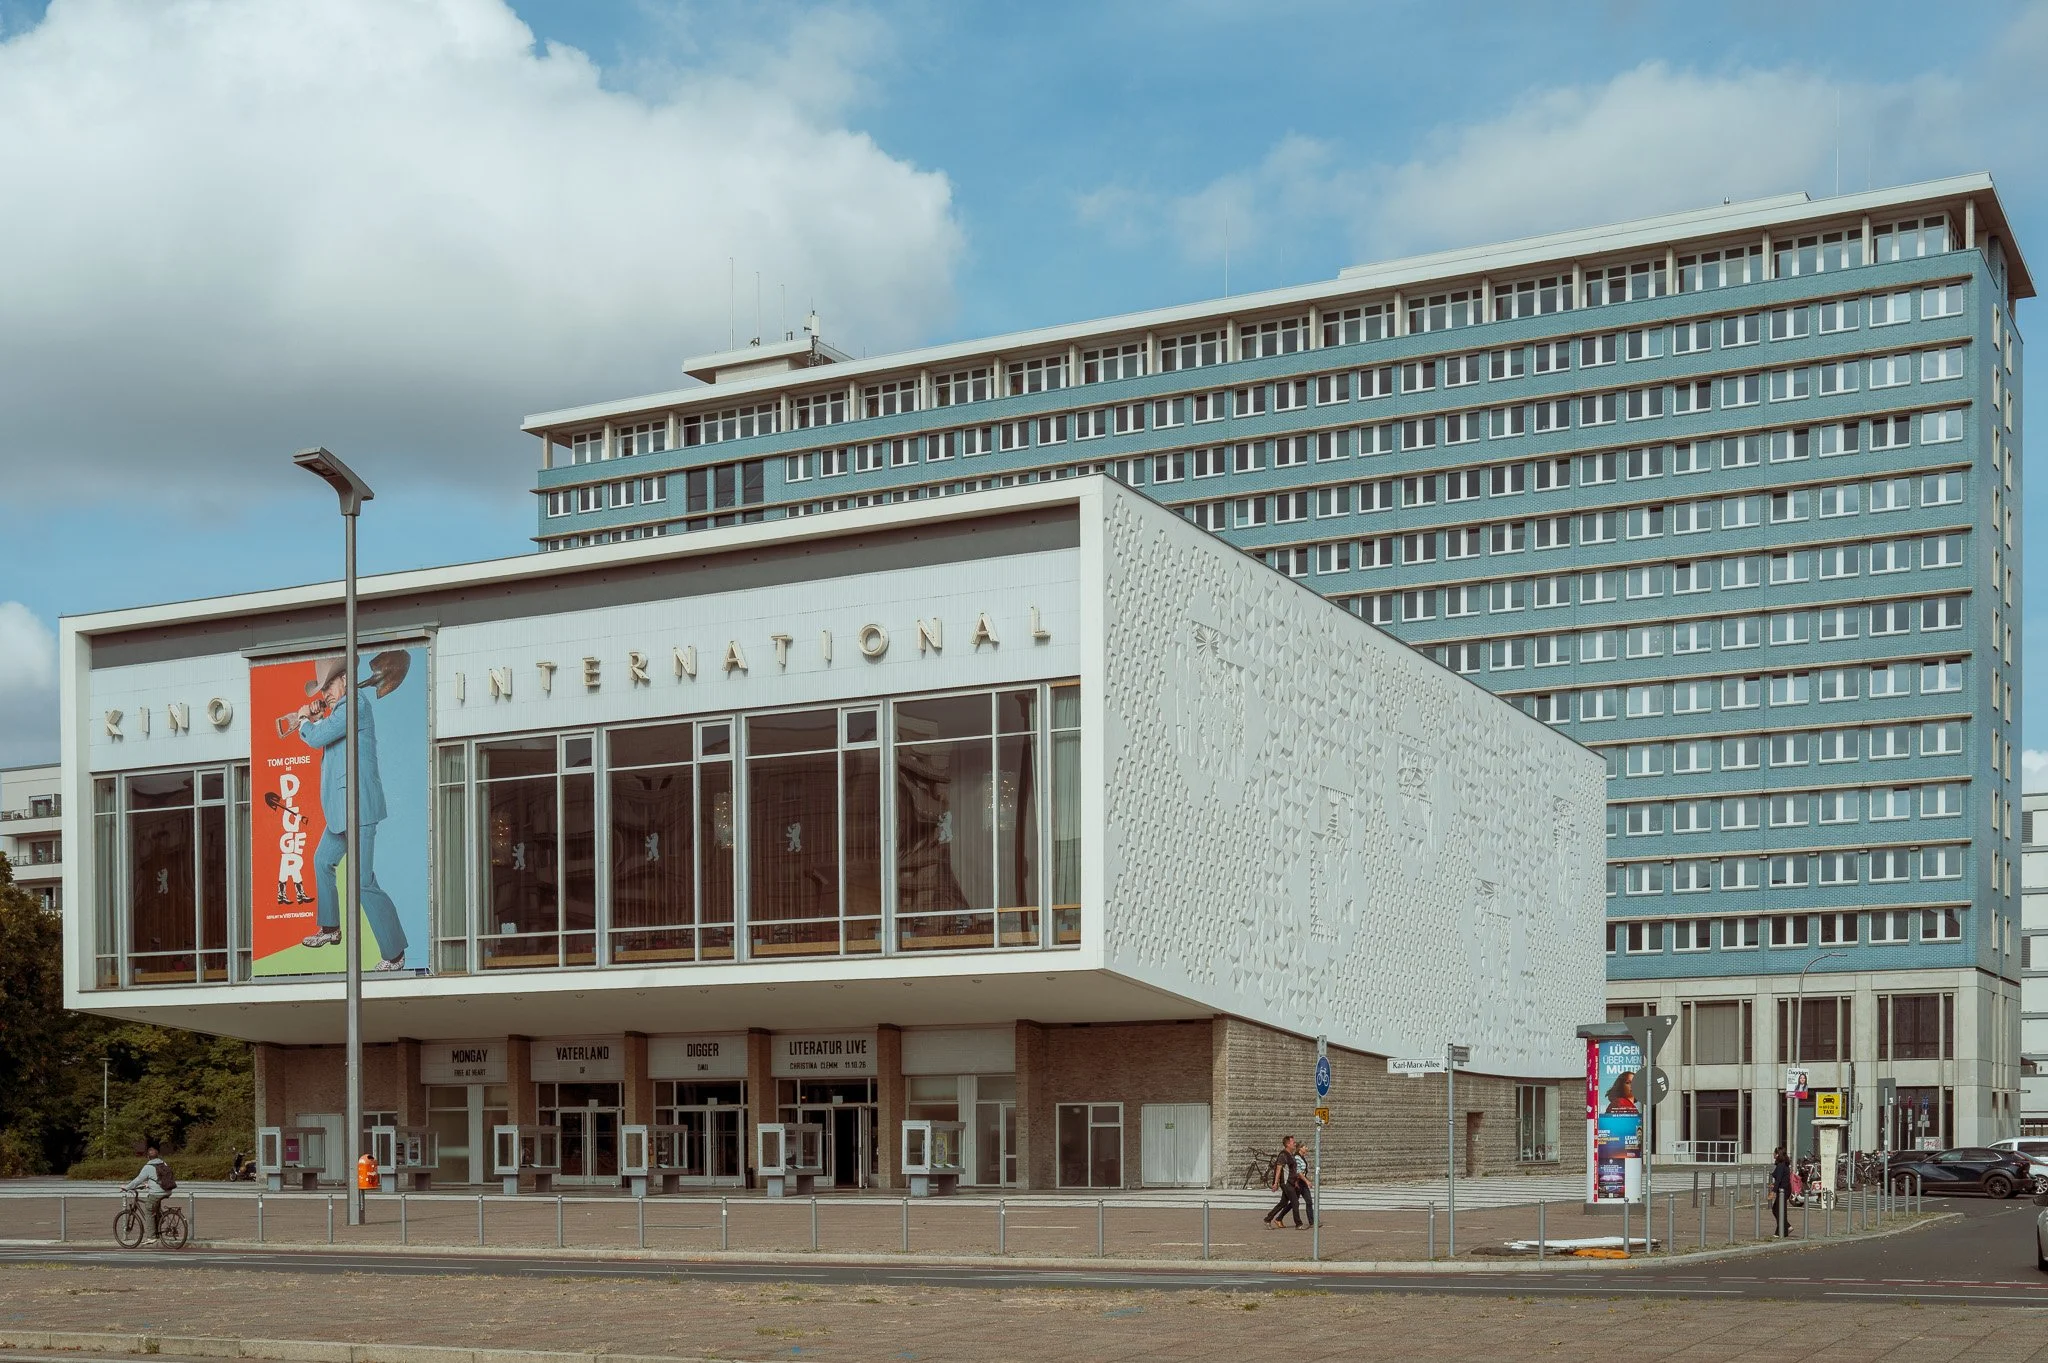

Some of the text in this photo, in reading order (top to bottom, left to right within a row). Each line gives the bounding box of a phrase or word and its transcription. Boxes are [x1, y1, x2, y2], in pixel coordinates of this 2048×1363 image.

[105, 606, 1051, 738] KINO INTERNATIONAL
[267, 756, 311, 767] TOM CRUISE
[556, 1046, 609, 1060] VATERLAND
[687, 1043, 719, 1057] DIGGER
[789, 1039, 867, 1055] LITERATUR LIVE
[1609, 1043, 1640, 1055] LÜGEN
[452, 1049, 488, 1063] MONGAY
[1602, 1055, 1624, 1065] ÜBER
[789, 1062, 818, 1070] CHRISTINA
[1392, 1061, 1440, 1069] Karl-Marx-Allee
